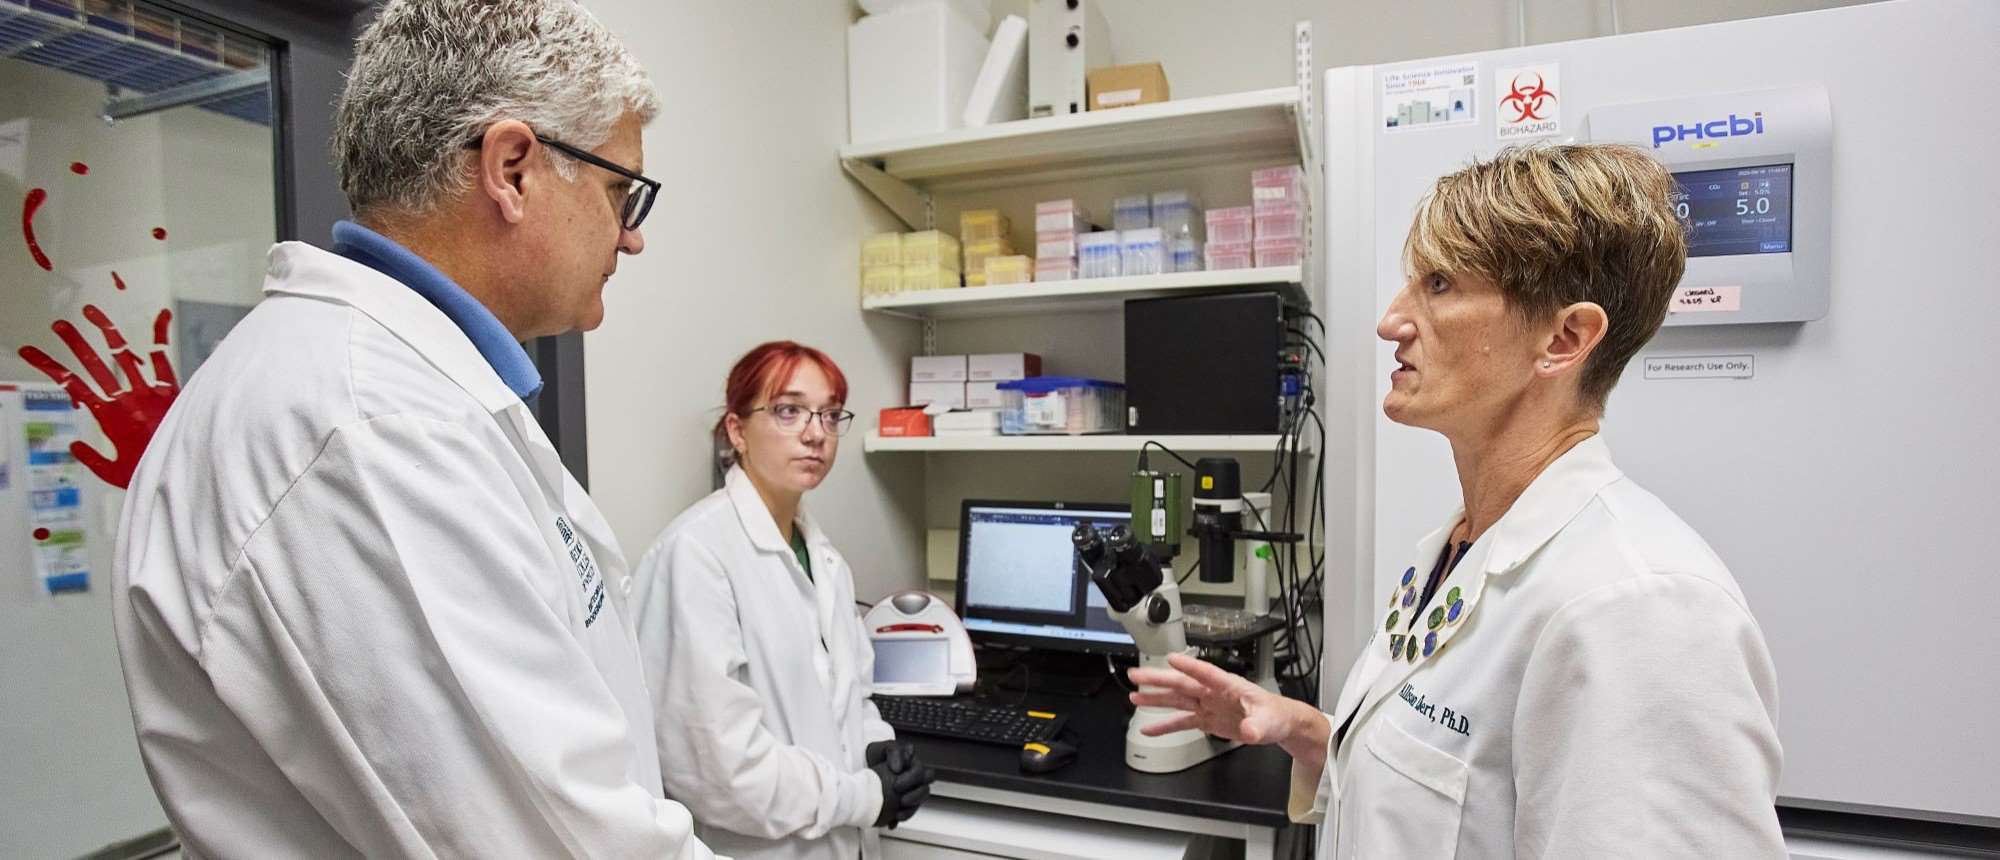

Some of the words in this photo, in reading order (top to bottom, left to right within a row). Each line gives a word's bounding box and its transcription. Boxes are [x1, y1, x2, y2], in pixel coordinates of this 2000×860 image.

[1403, 71, 1432, 81] Science
[1500, 121, 1557, 137] BIOHAZARD
[1735, 197, 1770, 216] 5.0
[1648, 364, 1661, 372] For
[1664, 362, 1705, 371] Research
[1706, 362, 1723, 371] Use
[1725, 361, 1750, 372] Only.
[1440, 707, 1469, 736] Ph.D.
